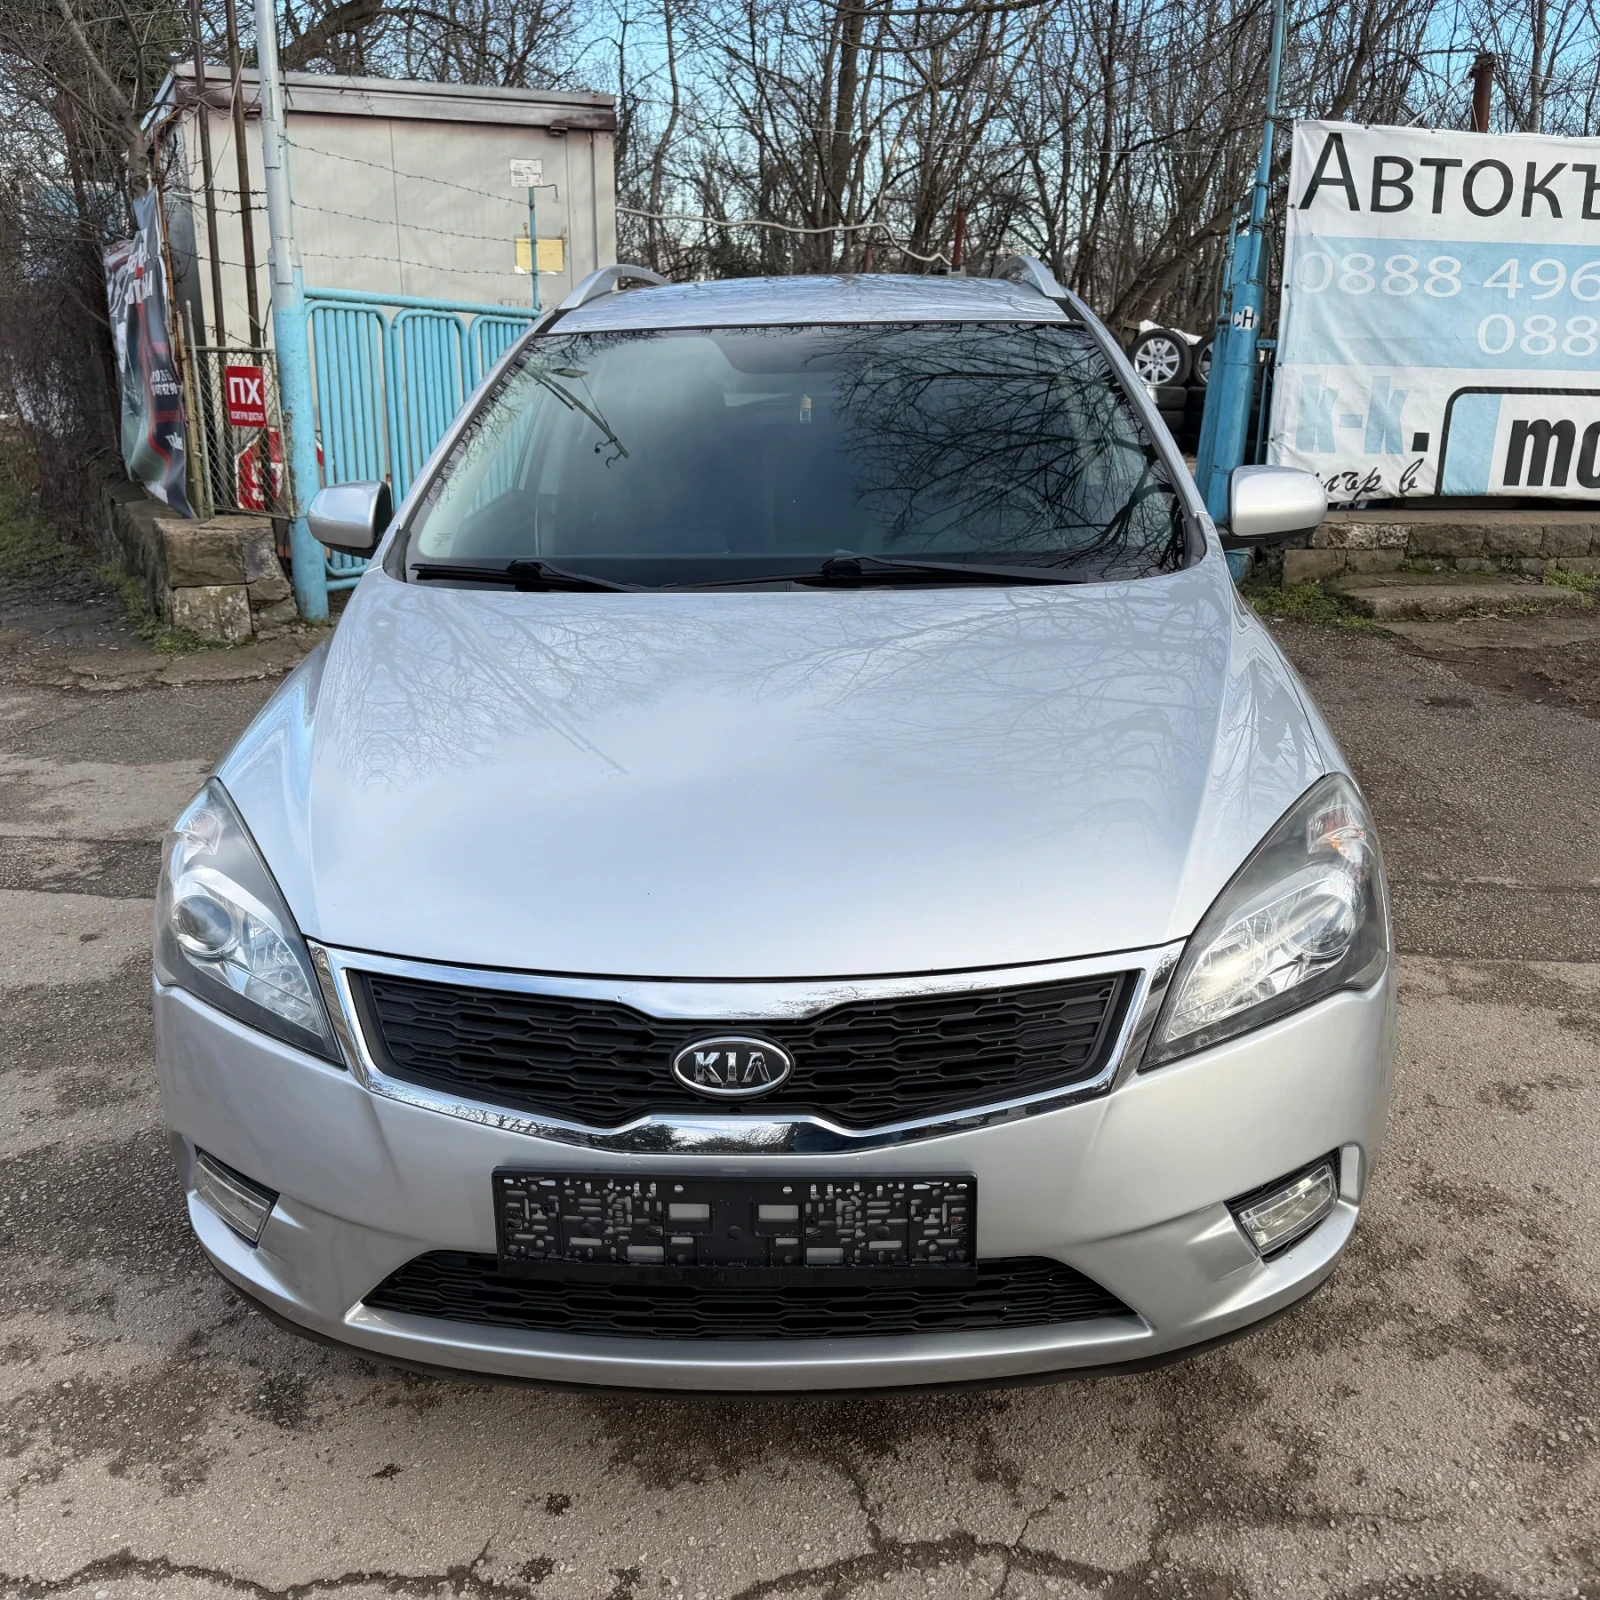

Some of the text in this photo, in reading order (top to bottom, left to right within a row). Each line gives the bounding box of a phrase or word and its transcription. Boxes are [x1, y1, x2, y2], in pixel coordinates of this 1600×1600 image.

[1295, 251, 1600, 303] 0888 496
[1477, 313, 1598, 357] 088
[229, 377, 262, 406] ПХ
[693, 1051, 772, 1083] KIA
